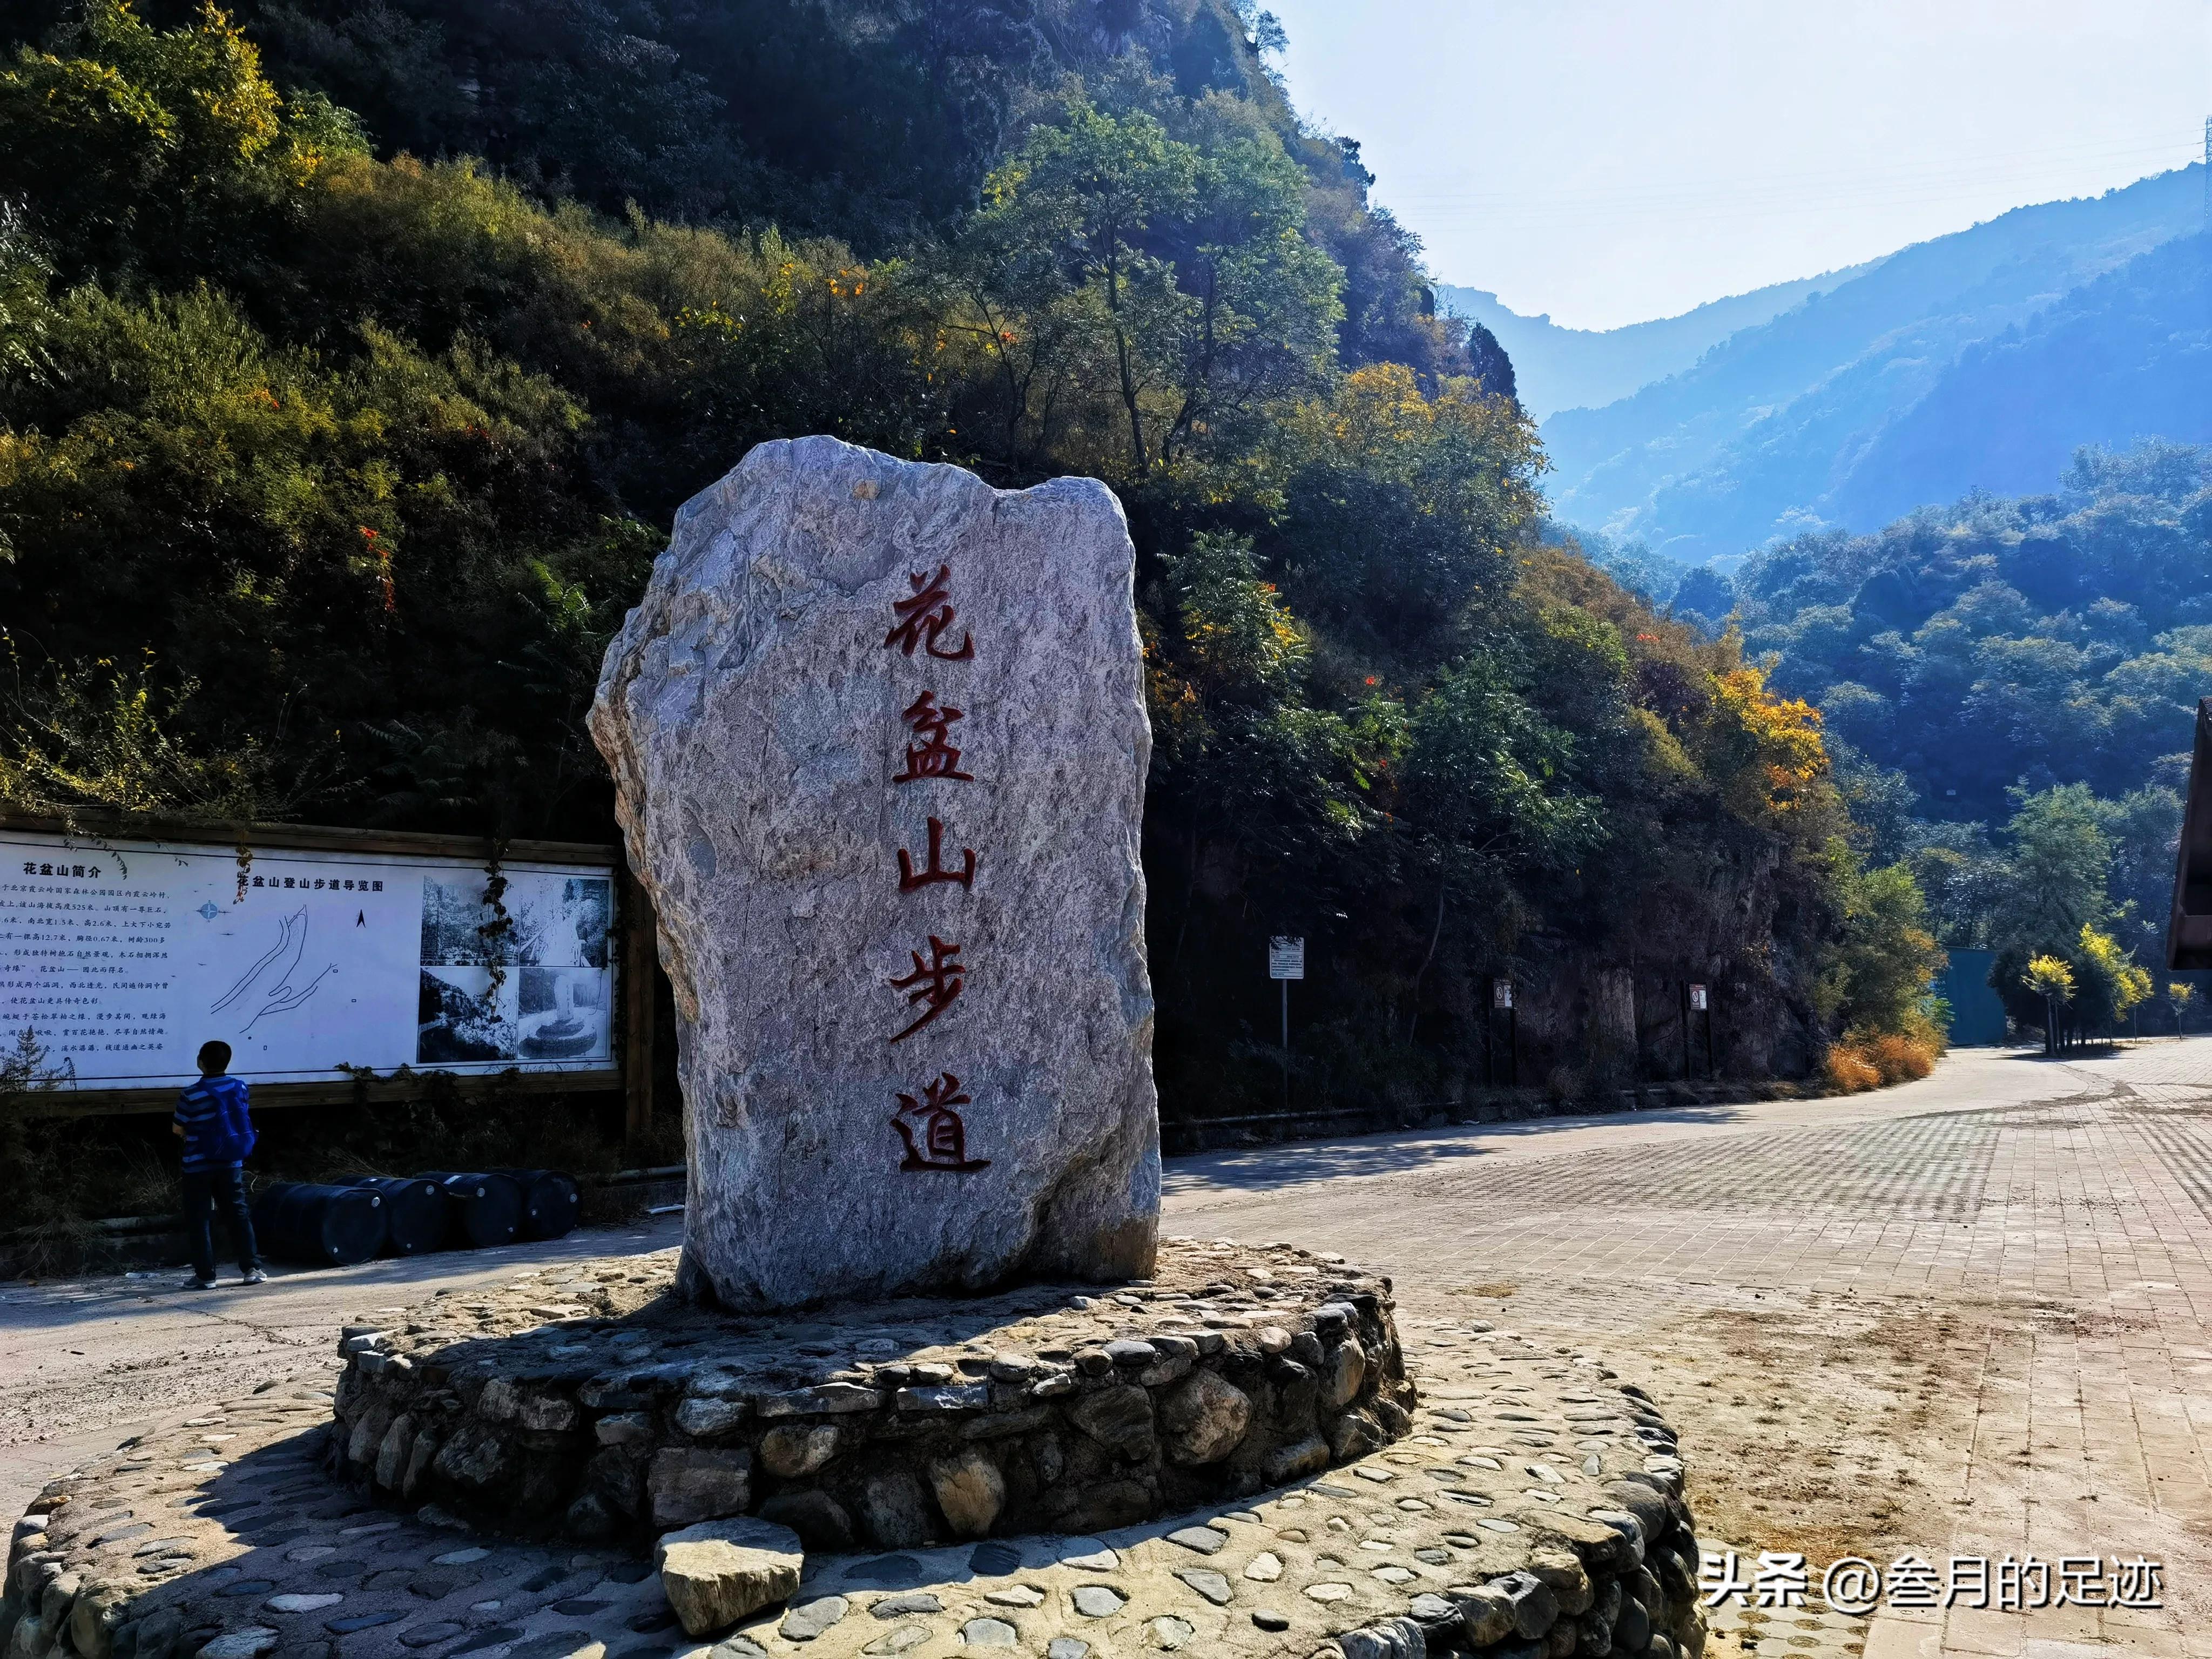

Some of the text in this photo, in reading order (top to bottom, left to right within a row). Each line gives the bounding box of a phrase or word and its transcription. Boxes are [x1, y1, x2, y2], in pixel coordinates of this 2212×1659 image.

[23, 862, 102, 879] 花盆山简介
[885, 563, 992, 1172] 花盆山步道
[237, 874, 383, 892] 花盆山登山步道导览图
